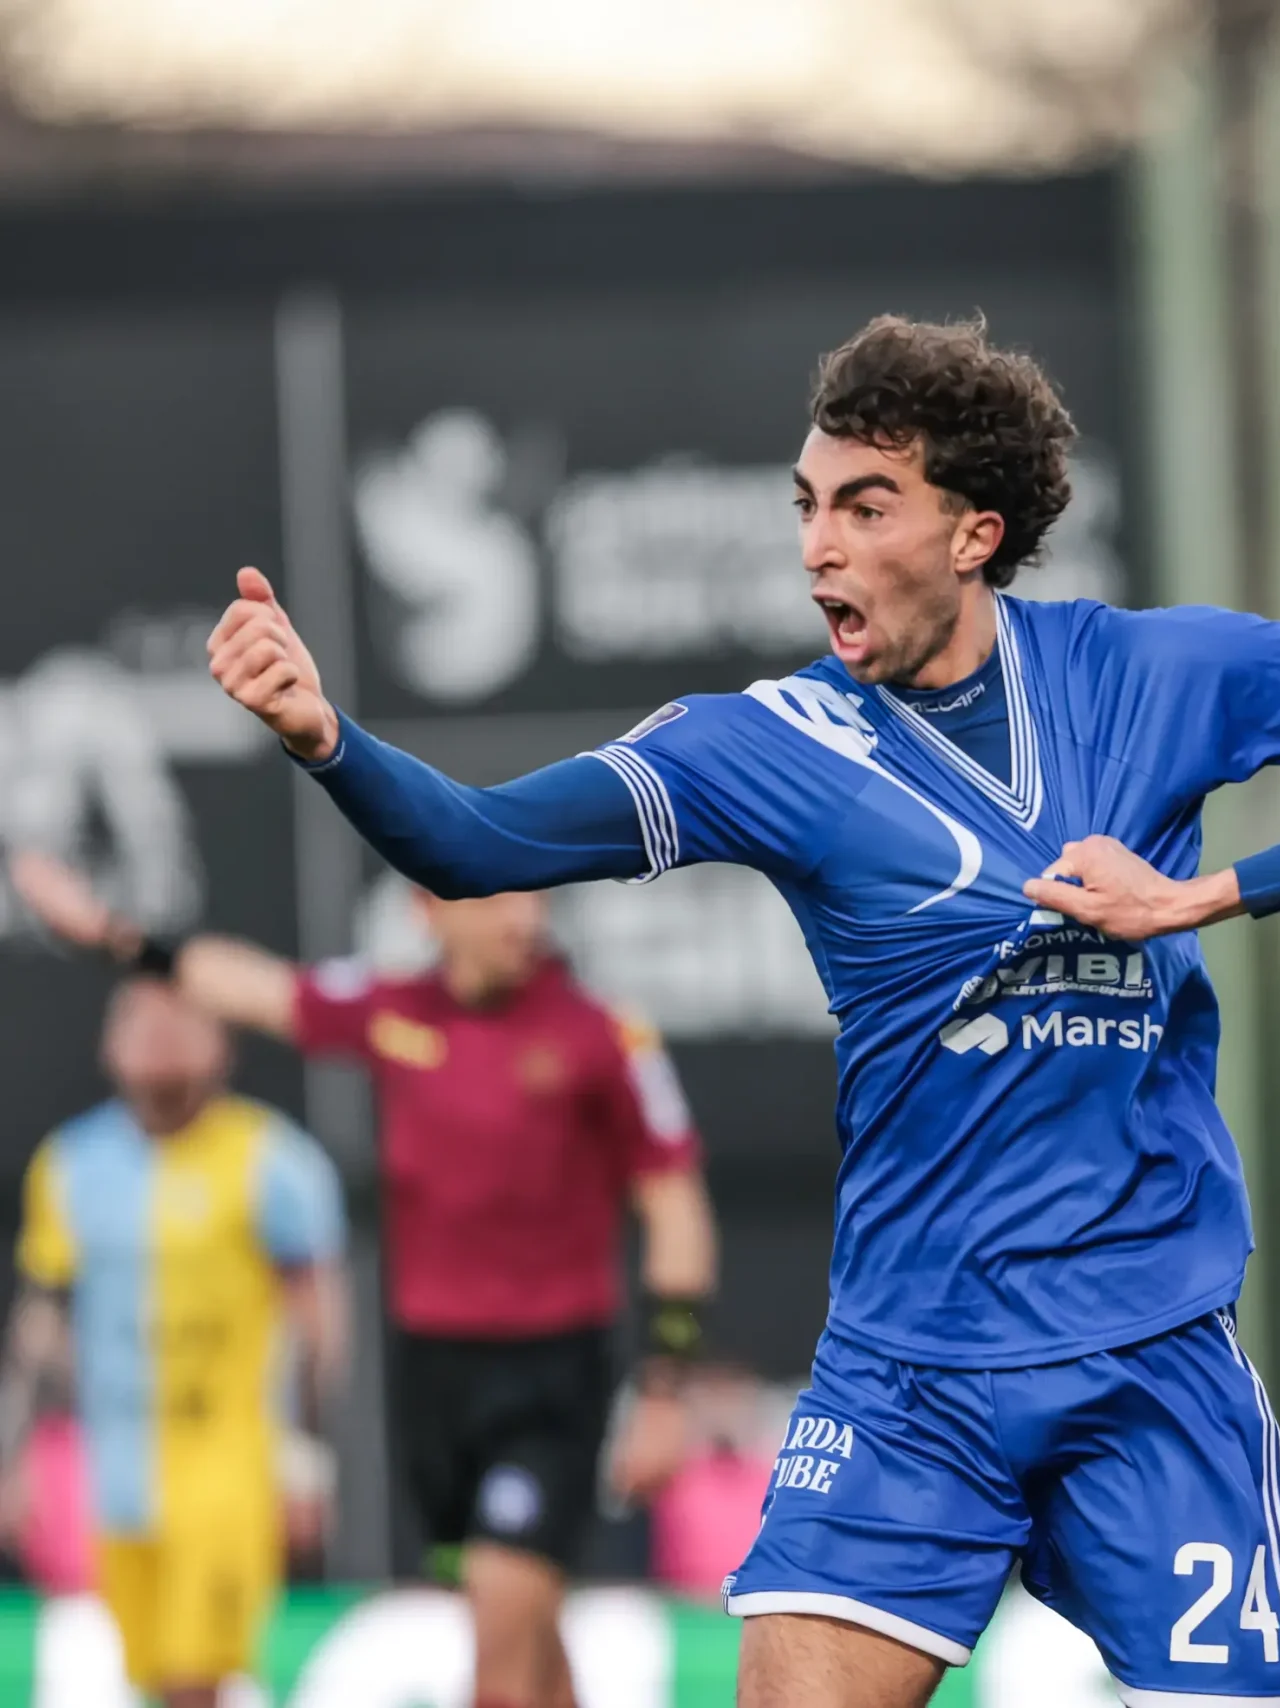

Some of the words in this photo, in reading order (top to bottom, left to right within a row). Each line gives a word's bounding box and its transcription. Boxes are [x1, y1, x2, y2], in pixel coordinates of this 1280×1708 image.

[1021, 1010, 1164, 1052] Marsh
[781, 1416, 854, 1460] RDA
[773, 1455, 841, 1494] UBE
[1169, 1541, 1280, 1664] 24
